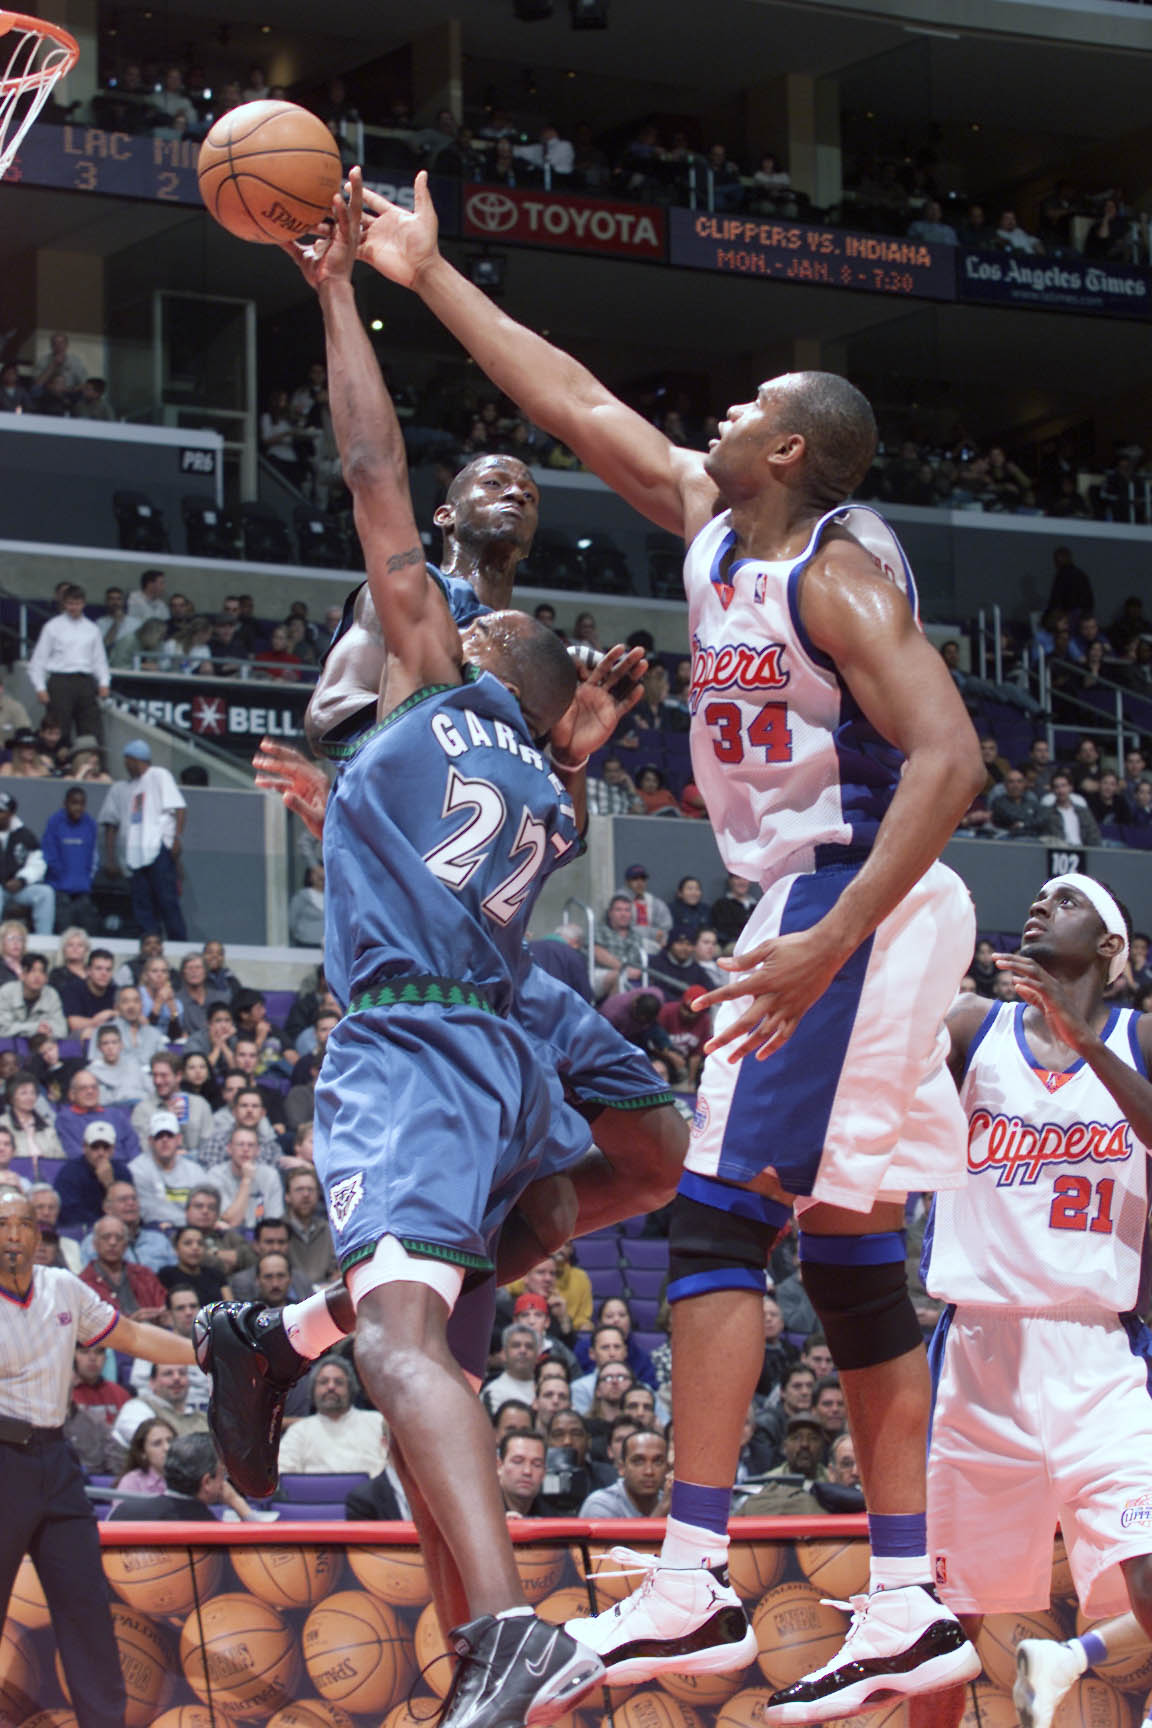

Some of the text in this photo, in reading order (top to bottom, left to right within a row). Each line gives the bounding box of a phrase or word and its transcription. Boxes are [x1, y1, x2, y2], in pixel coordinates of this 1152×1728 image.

[63, 125, 133, 161] LAC
[74, 160, 181, 200] 3 2
[523, 202, 659, 247] TOYOTA
[695, 216, 803, 249] CLIPPERS
[844, 236, 932, 268] INDIANA
[965, 254, 1147, 297] Los Angeles Times
[704, 700, 793, 765] 34
[421, 764, 547, 927] 22
[1052, 852, 1080, 876] 102
[967, 1108, 1133, 1188] Clippers
[1048, 1174, 1115, 1234] 21
